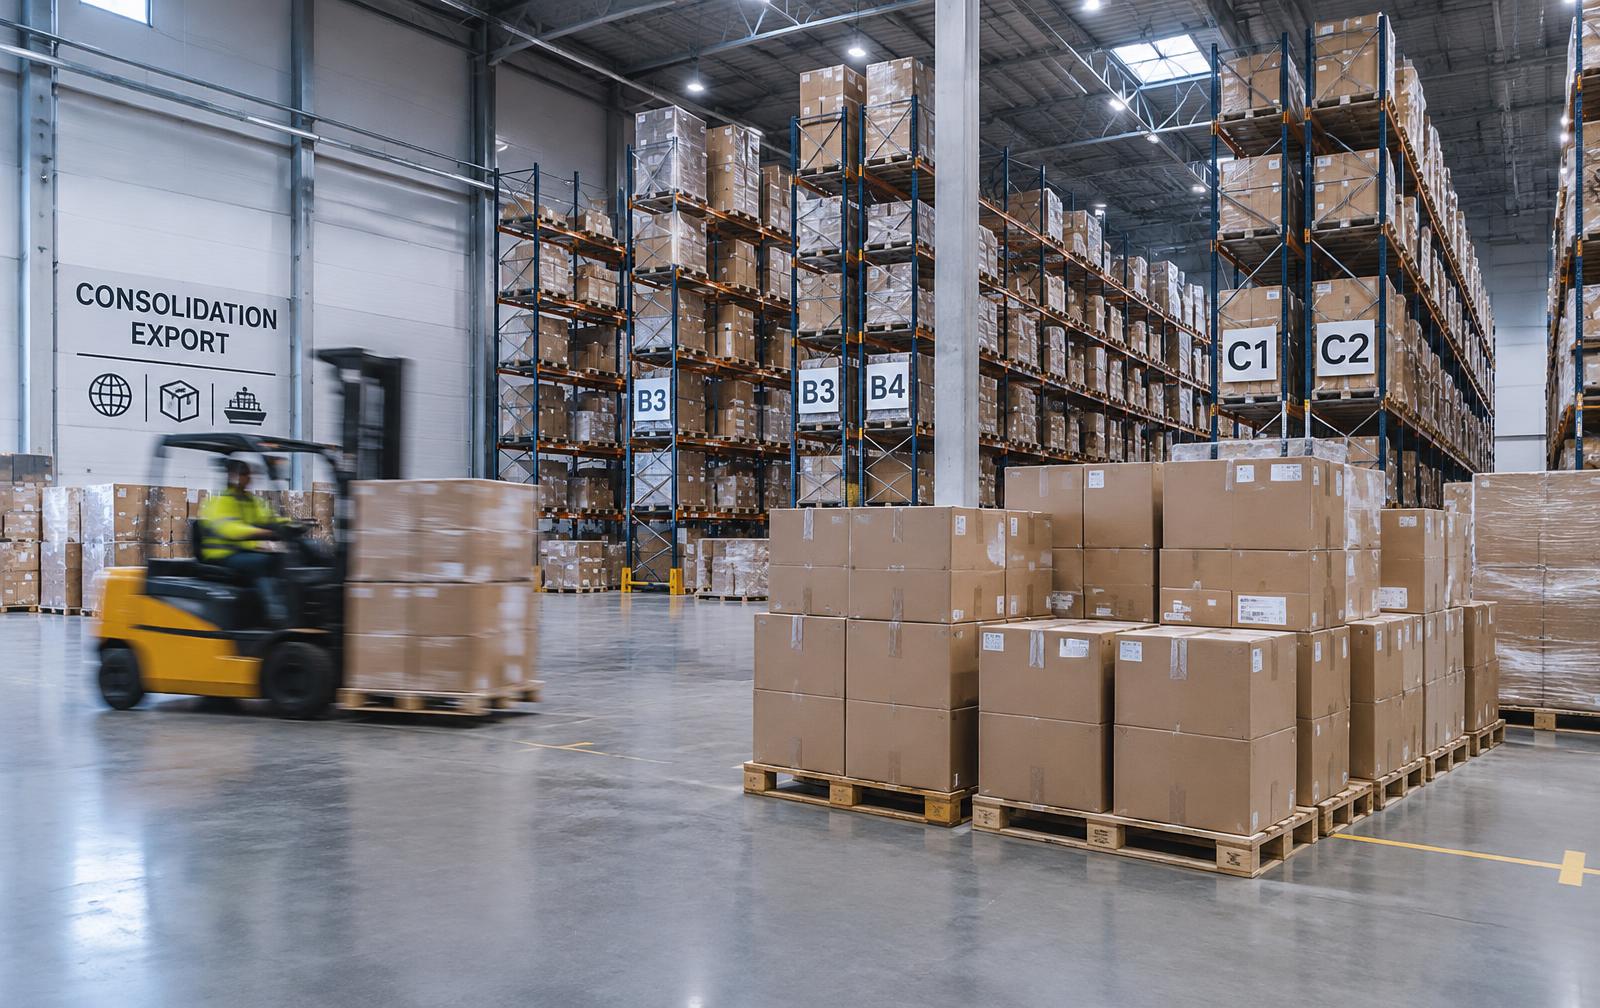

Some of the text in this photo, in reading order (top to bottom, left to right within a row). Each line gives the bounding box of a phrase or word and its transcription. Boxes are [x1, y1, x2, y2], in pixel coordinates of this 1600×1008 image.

[76, 282, 276, 329] CONSOLIDATION
[131, 321, 228, 353] EXPORT
[1321, 332, 1368, 364] C2
[1228, 340, 1267, 370] C1
[638, 388, 666, 412] B3
[802, 378, 835, 404] B3
[870, 373, 905, 400] B4
